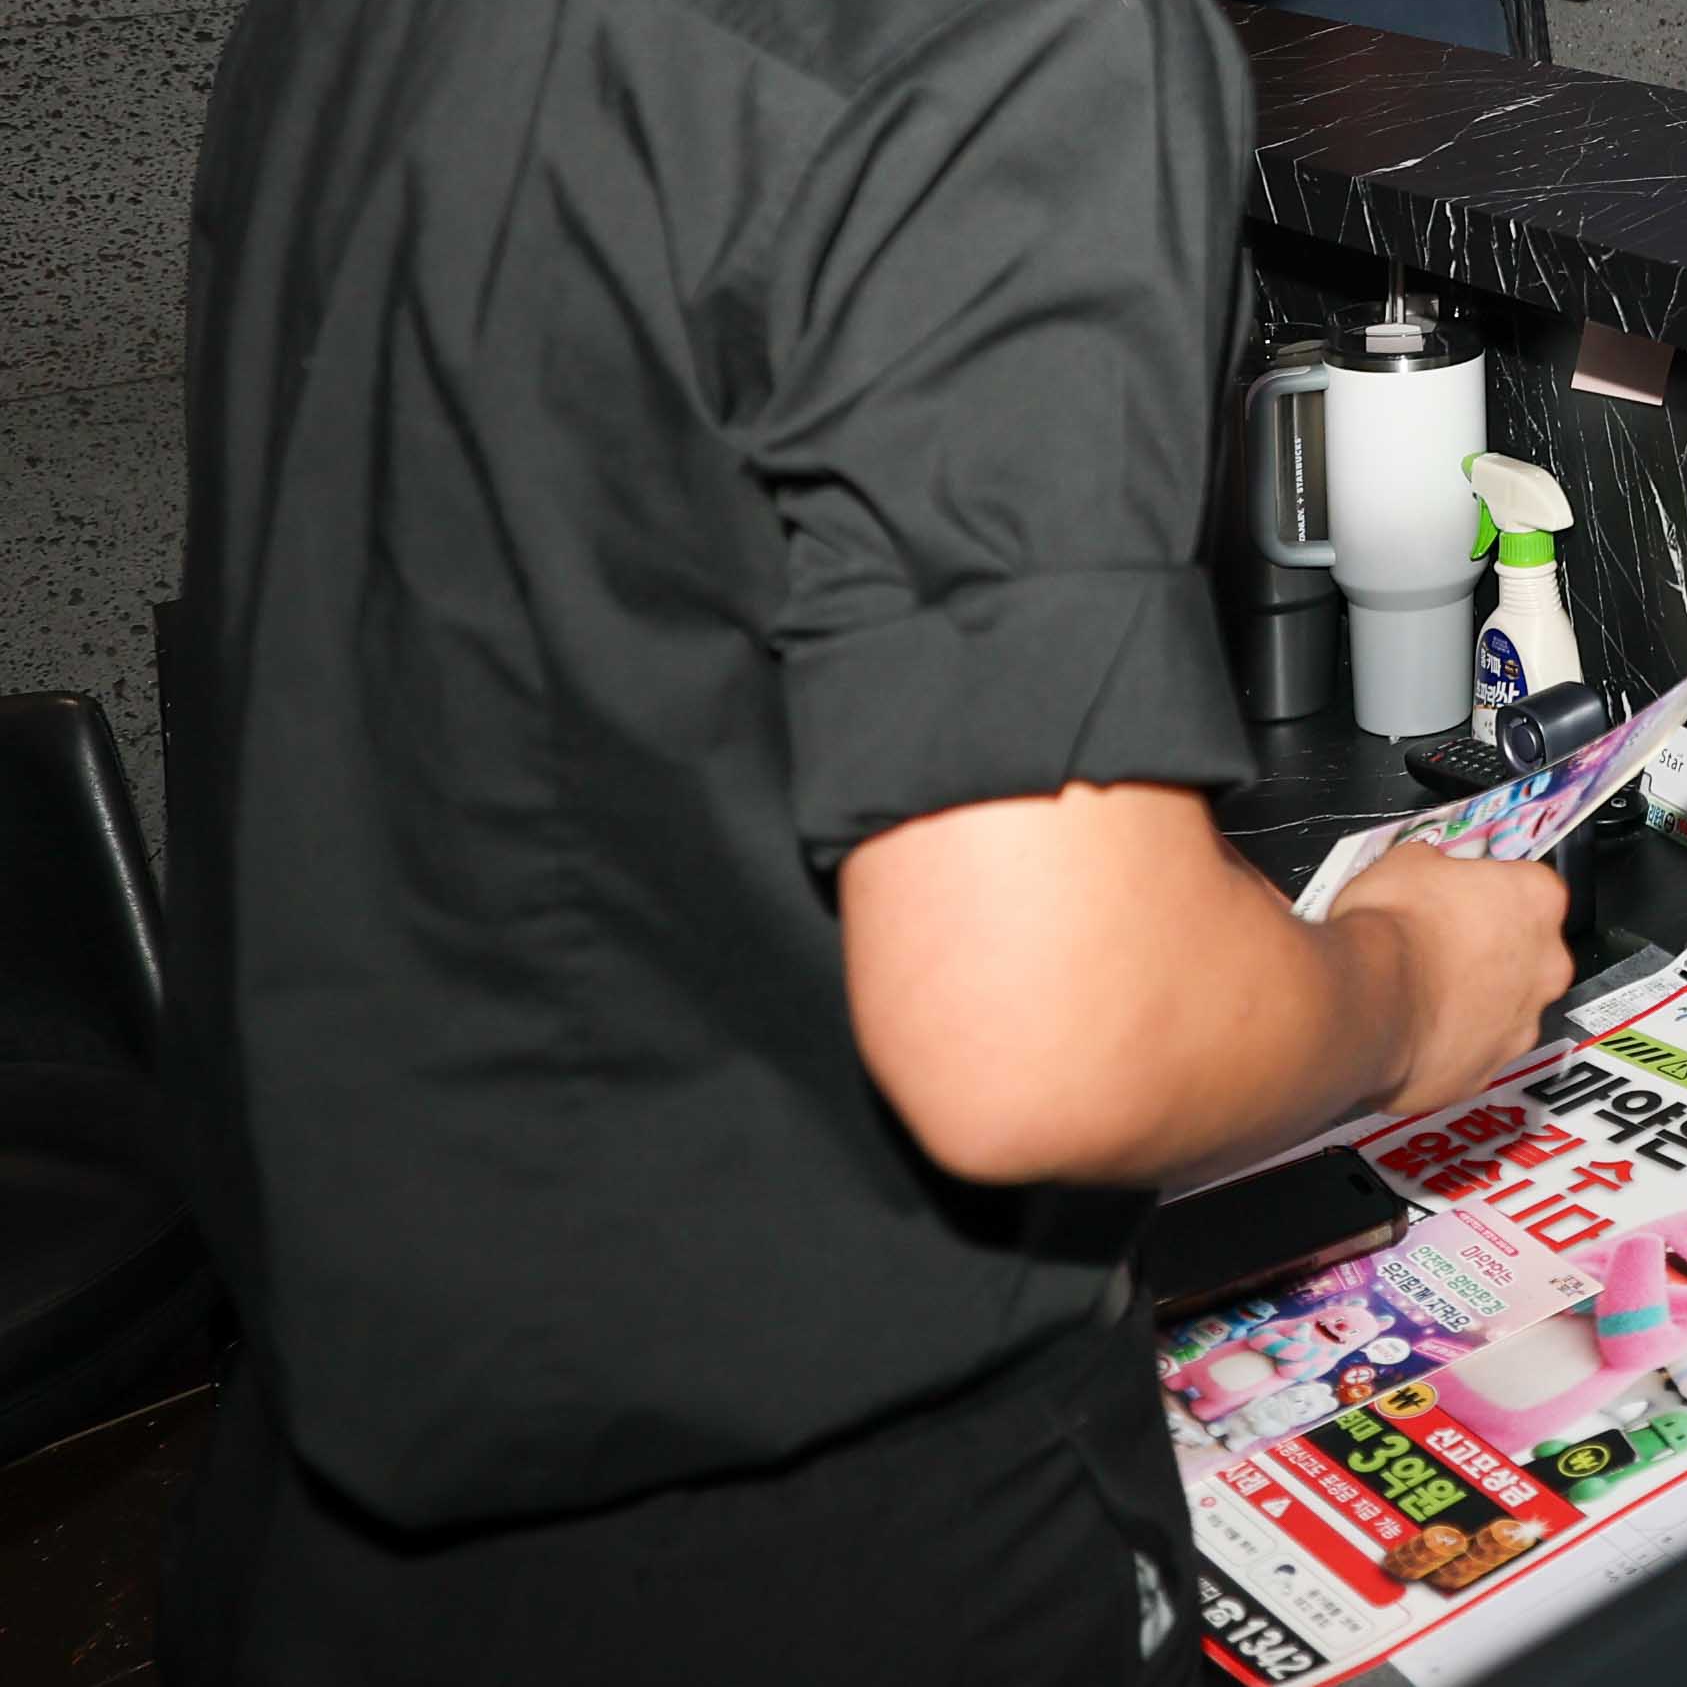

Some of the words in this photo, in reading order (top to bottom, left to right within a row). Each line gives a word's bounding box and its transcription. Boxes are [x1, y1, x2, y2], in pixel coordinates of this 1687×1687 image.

[1659, 749, 1684, 773] Star
[1376, 1131, 1616, 1252] 없습니다
[1447, 1103, 1588, 1171] 숨길
[1567, 1159, 1633, 1194] 수
[1276, 1440, 1328, 1479] 명신고도
[1352, 1497, 1382, 1521] 지급
[1374, 1515, 1404, 1541] 가능
[1348, 1434, 1467, 1523] 3억원
[1425, 1428, 1540, 1508] 신고포상금
[1225, 1617, 1314, 1681] 1342
